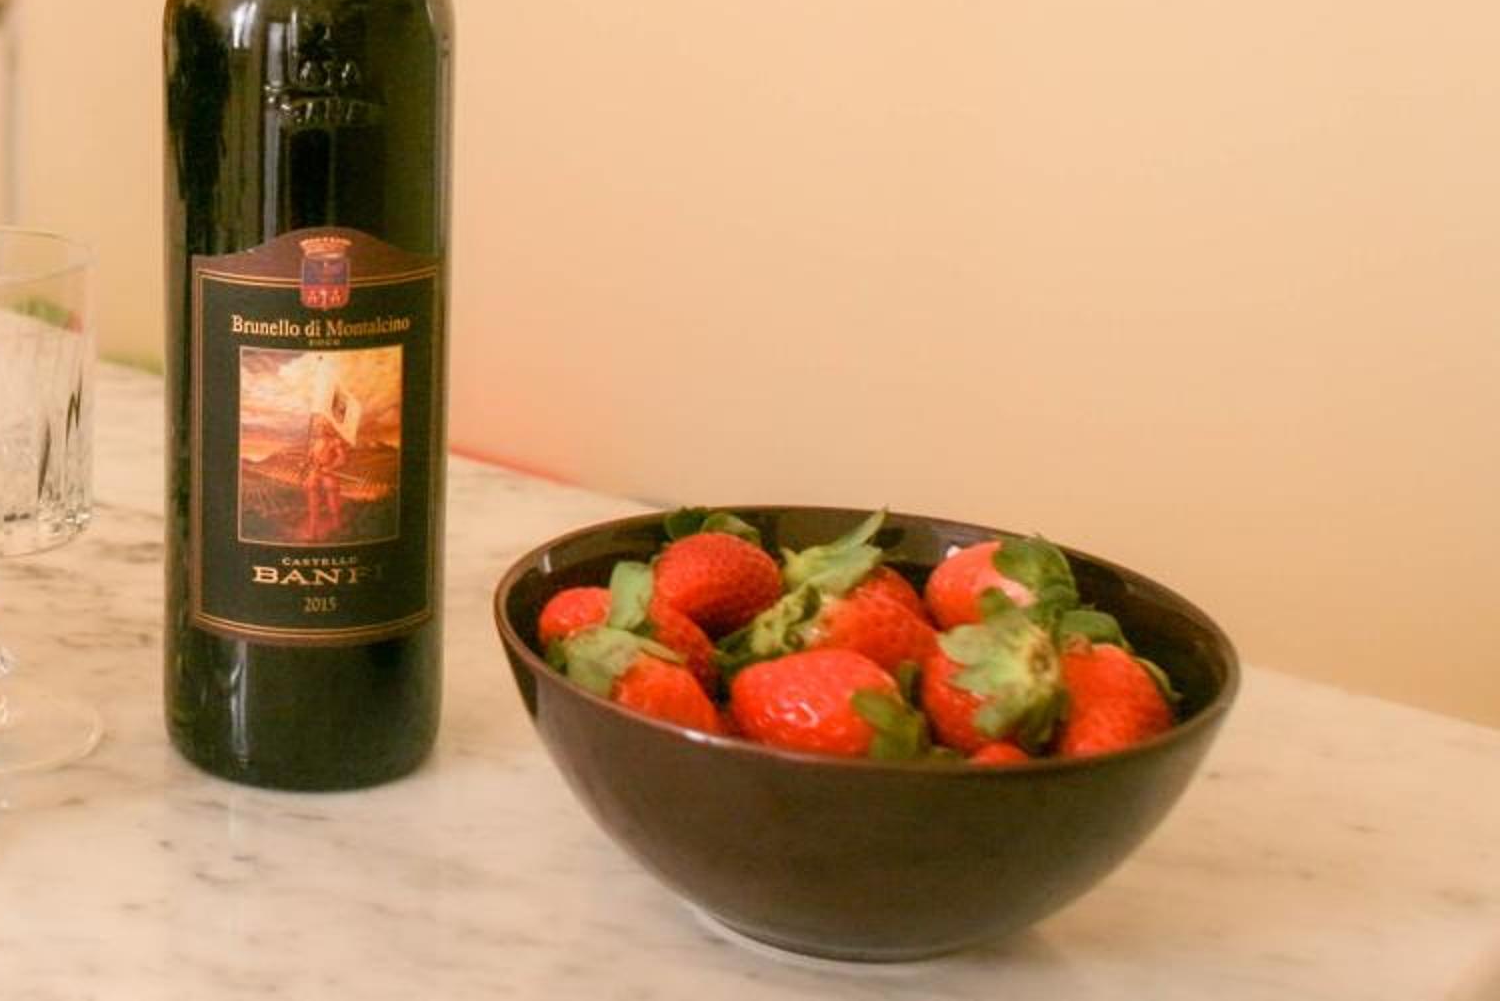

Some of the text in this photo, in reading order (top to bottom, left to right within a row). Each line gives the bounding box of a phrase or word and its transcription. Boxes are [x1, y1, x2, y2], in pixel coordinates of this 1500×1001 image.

[232, 314, 411, 338] Brunello di Montalcino
[304, 596, 338, 613] 2015
